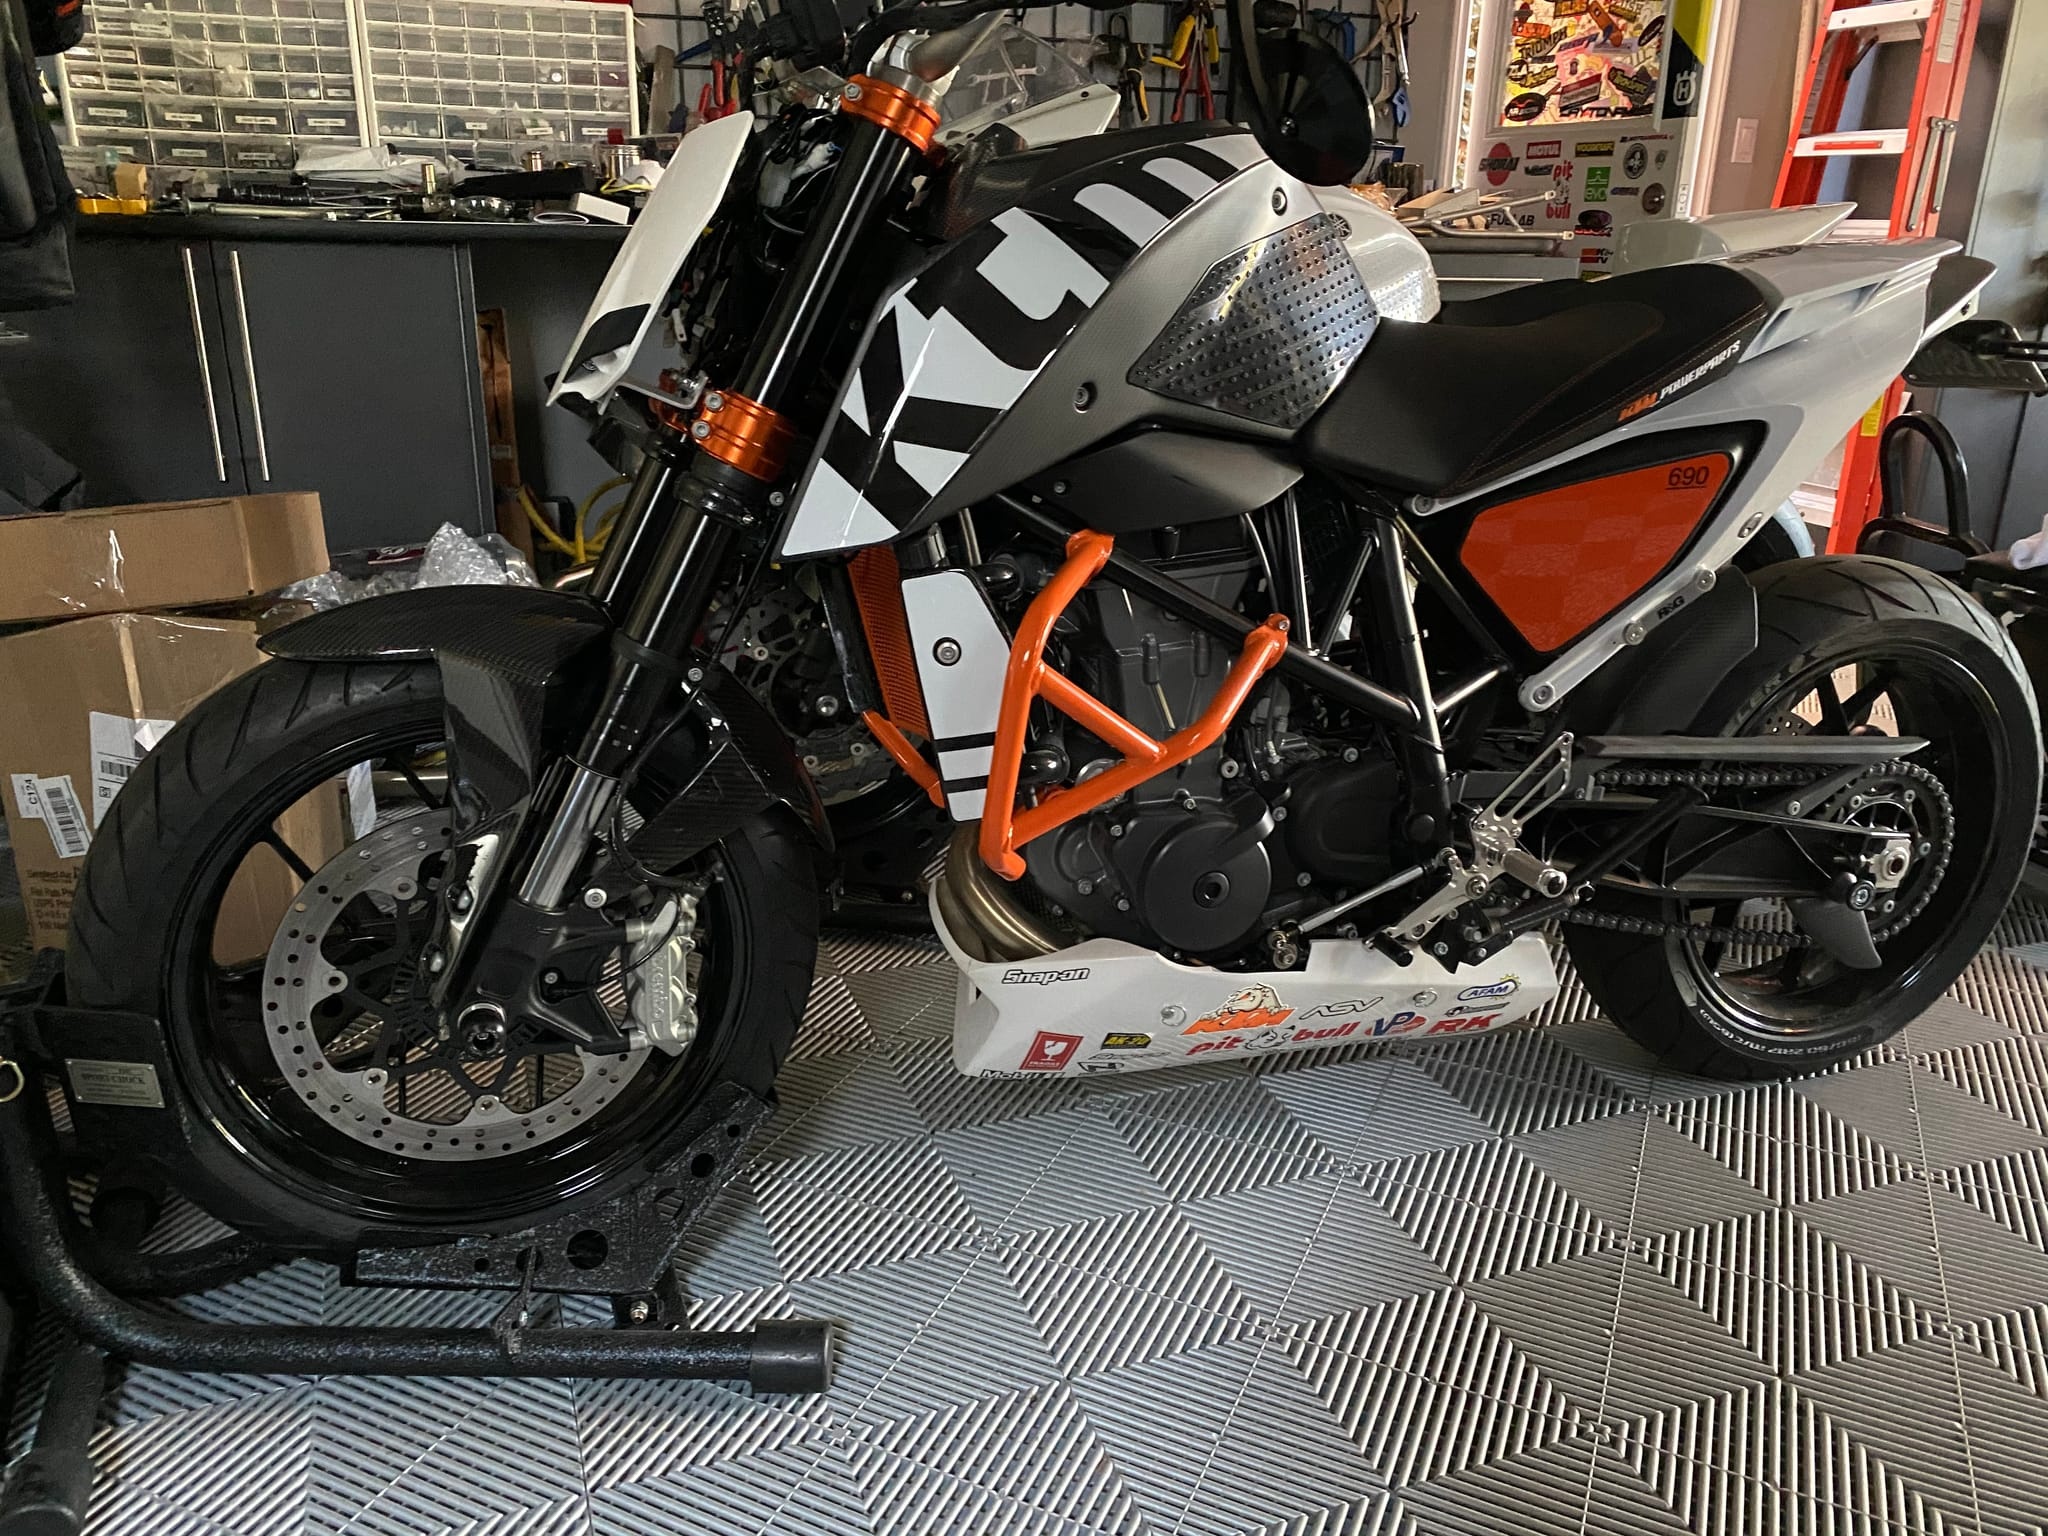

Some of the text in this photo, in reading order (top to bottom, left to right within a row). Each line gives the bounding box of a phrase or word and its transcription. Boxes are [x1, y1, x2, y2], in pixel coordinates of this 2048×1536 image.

[1528, 143, 1559, 157] MOTUL
[1553, 160, 1574, 181] pit
[1490, 213, 1535, 226] FUEAB
[1546, 203, 1571, 220] bull
[1659, 339, 1742, 400] POWERPARTS
[1667, 465, 1711, 488] 690
[24, 778, 38, 805] C124
[1001, 968, 1091, 986] Snap-on
[1467, 984, 1510, 997] AFAM
[1299, 996, 1385, 1021] ASV
[1372, 1011, 1416, 1036] VP
[1426, 1012, 1503, 1035] RK
[1185, 1021, 1361, 1056] pit bull
